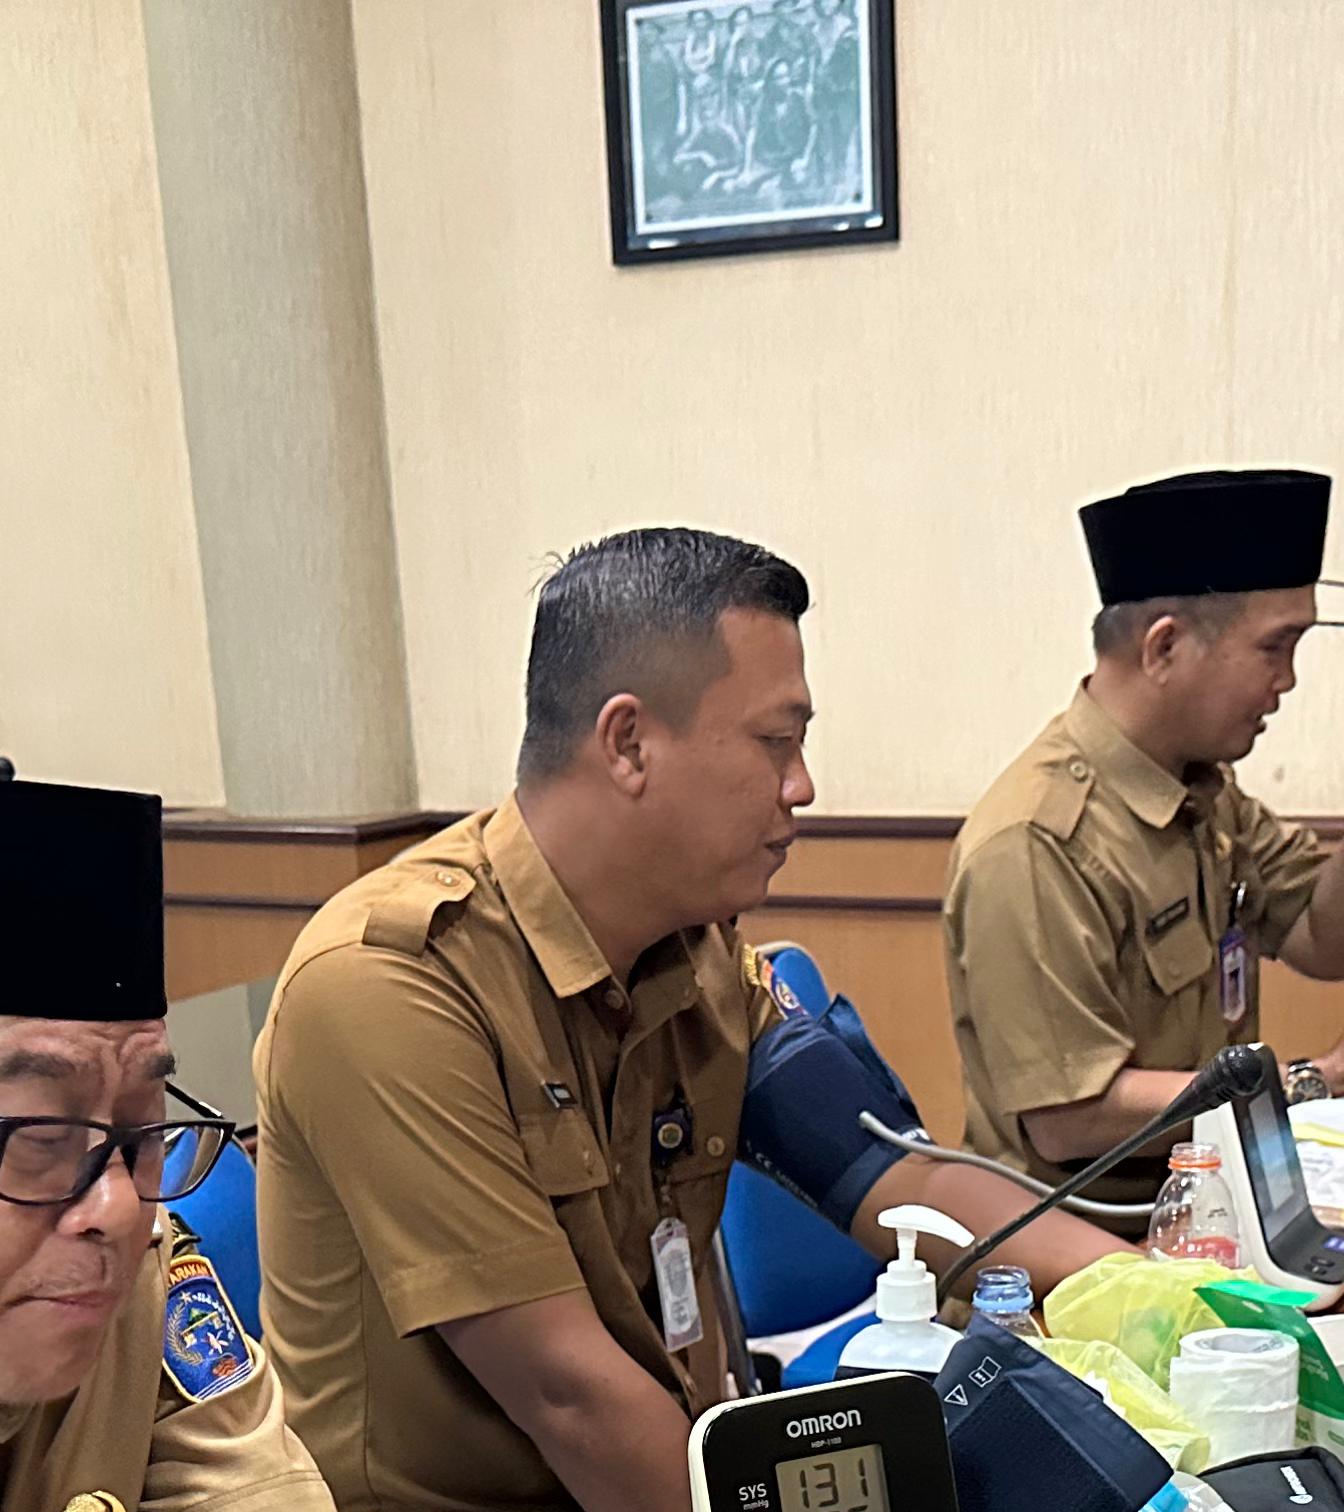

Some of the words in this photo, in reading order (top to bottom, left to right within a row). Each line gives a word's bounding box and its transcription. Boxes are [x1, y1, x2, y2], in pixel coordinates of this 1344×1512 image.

[167, 1263, 209, 1288] ARAKAN
[786, 1409, 862, 1438] OMRON
[739, 1483, 767, 1501] SYS
[799, 1458, 869, 1509] 131
